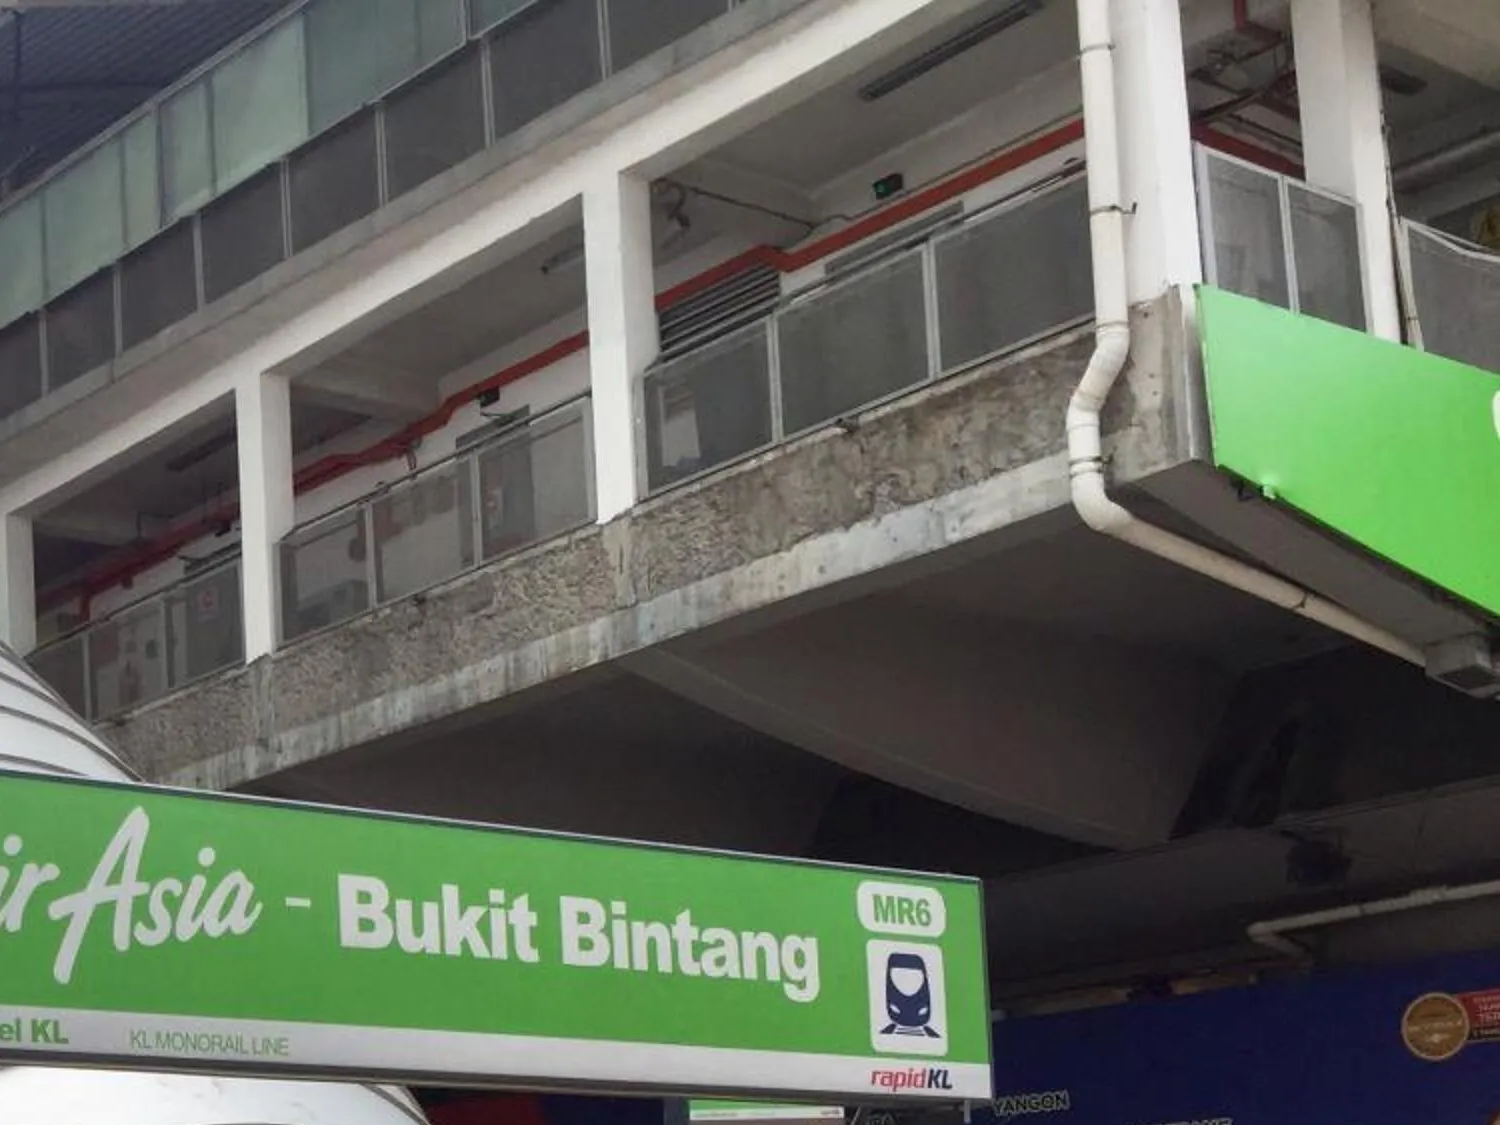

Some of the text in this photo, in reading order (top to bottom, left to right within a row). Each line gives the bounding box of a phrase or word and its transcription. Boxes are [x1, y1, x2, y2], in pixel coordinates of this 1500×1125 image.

[872, 894, 932, 928] MR6
[337, 873, 540, 963] Bukit
[559, 895, 820, 1003] Bintang
[30, 1018, 69, 1044] KL
[130, 1030, 290, 1056] KL MONORAIL LINE
[870, 1067, 953, 1093] rapidKL
[992, 1090, 1070, 1116] YANGON
